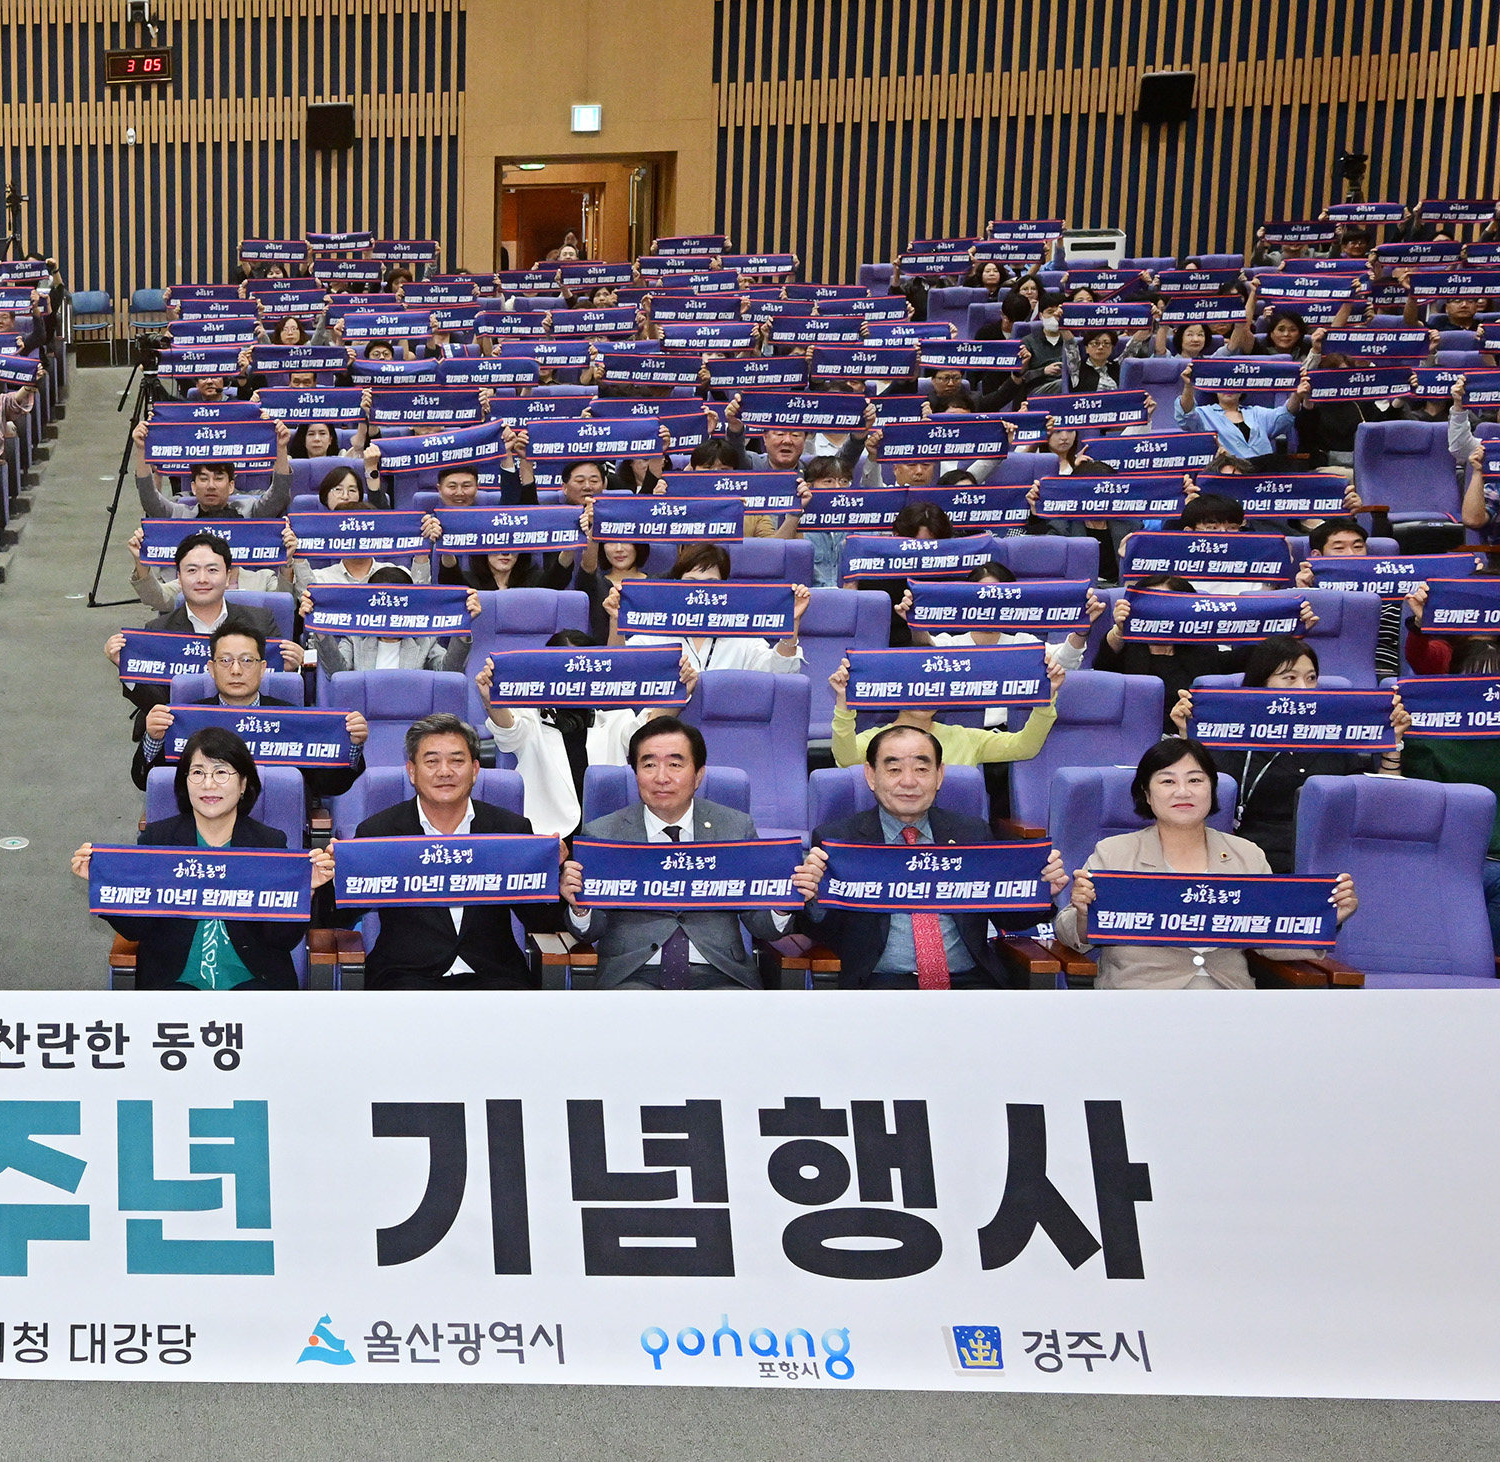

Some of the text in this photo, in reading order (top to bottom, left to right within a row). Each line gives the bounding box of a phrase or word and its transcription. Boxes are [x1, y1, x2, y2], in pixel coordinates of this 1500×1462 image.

[151, 443, 270, 456] 함께한 10년! 함께할 미래!
[685, 589, 727, 605] 해오름동맹
[976, 584, 1021, 599] 해오름동맹
[914, 606, 1081, 620] 함께한 10년! 함께할 미래!
[1191, 599, 1237, 613] 해오름동맹
[626, 611, 785, 627] 함께한 10년! 함께할 미래!
[1130, 618, 1297, 634] 함께한 10년! 함께할 미래!
[565, 655, 611, 672] 해오름동맹
[922, 656, 971, 672] 해오름동맹
[499, 681, 677, 696] 함께한 10년! 함께할 미래!
[855, 679, 1040, 697] 함께한 10년! 함께할 미래!
[1267, 697, 1316, 715] 해오름동맹
[1196, 722, 1384, 740] 함께한 10년! 함께할 미래!
[419, 844, 473, 864] 해오름동맹
[661, 852, 716, 870] 해오름동맹
[906, 853, 962, 871] 해오름동맹
[173, 859, 226, 879] 해오름동맹
[346, 873, 547, 893] 함께한 10년! 함께할 미래!
[583, 879, 793, 897] 함께한 10년! 함께할 미래!
[828, 878, 1037, 899] 함께한 10년! 함께할 미래!
[100, 886, 299, 908] 함께한 10년! 함께할 미래!
[1180, 884, 1241, 904] 해오름동맹
[1097, 910, 1322, 934] 함께한 10년! 함께할 미래!
[153, 1021, 243, 1071] 동행
[372, 1097, 1153, 1280] 기념행사
[70, 1323, 196, 1364] 대강당
[364, 1321, 564, 1365] 울산광역시
[640, 1313, 855, 1381] pohang
[1022, 1330, 1151, 1372] 경주시
[758, 1361, 820, 1380] 포항시
